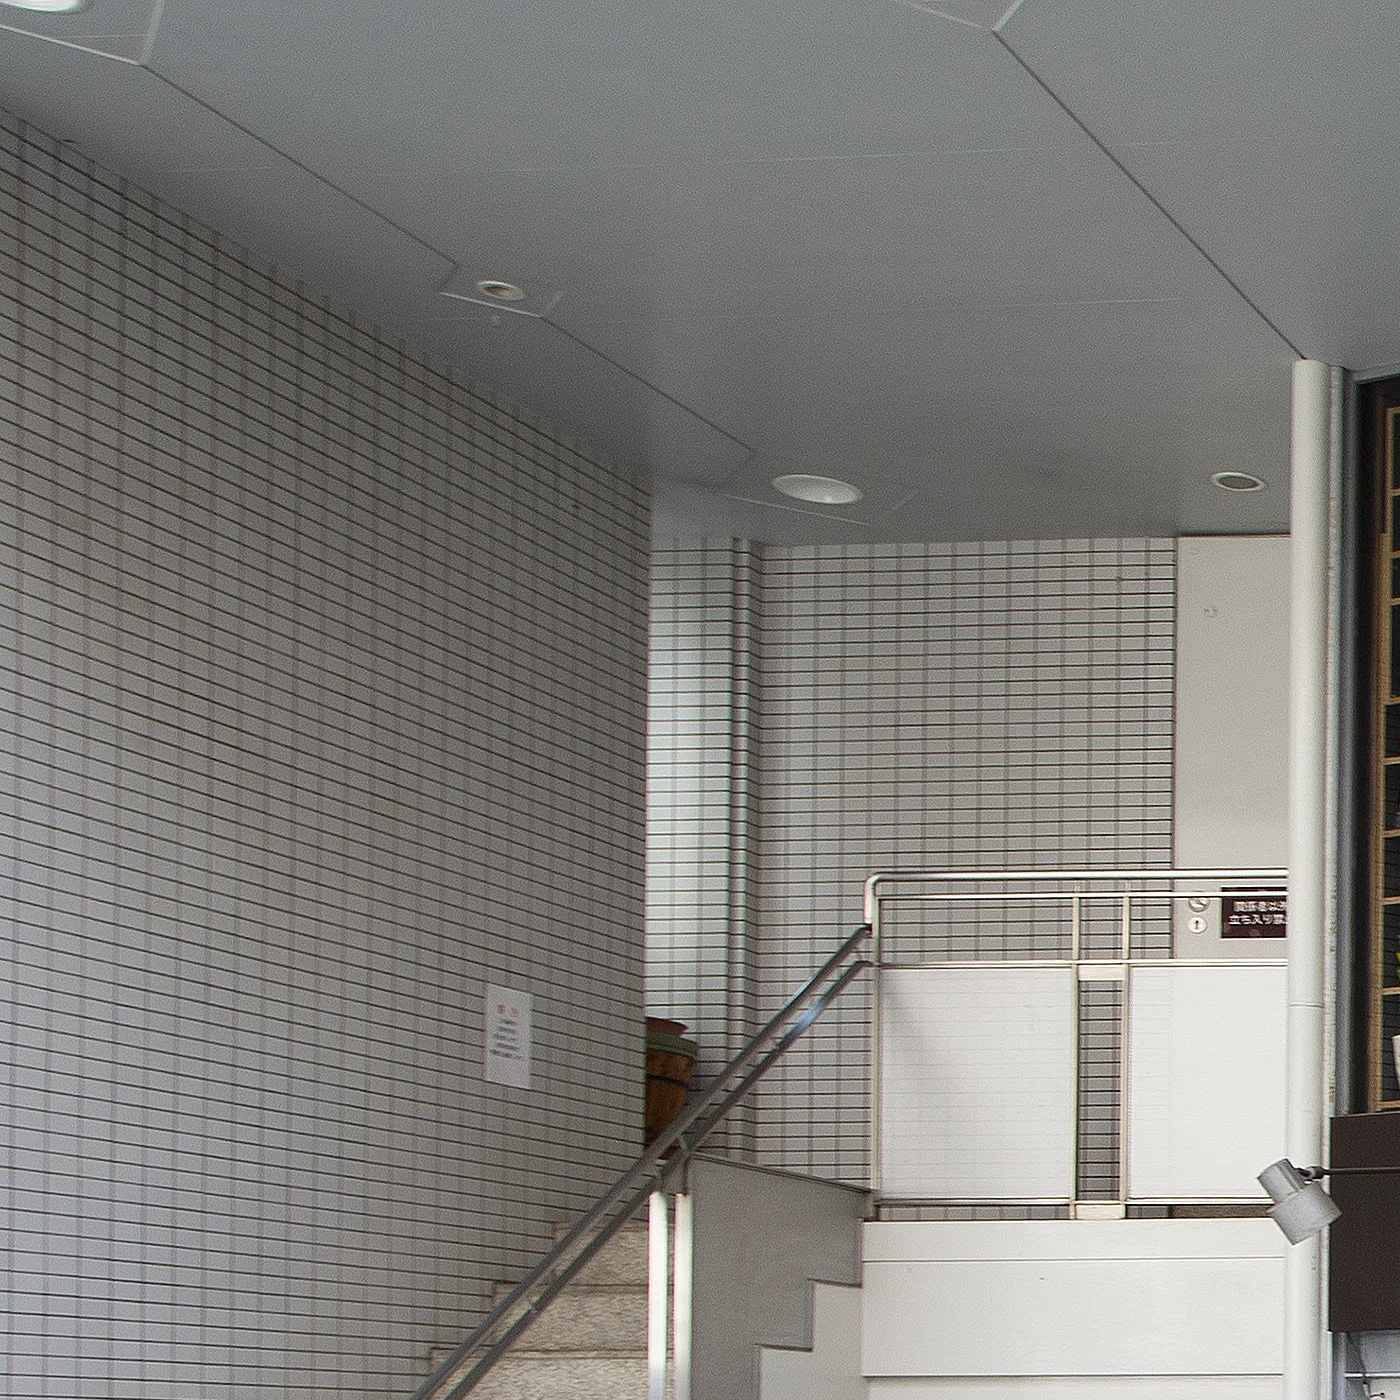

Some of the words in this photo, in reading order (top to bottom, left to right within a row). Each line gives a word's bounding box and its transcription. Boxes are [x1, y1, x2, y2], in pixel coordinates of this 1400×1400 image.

[1229, 914, 1287, 925] 立ち入り禁
